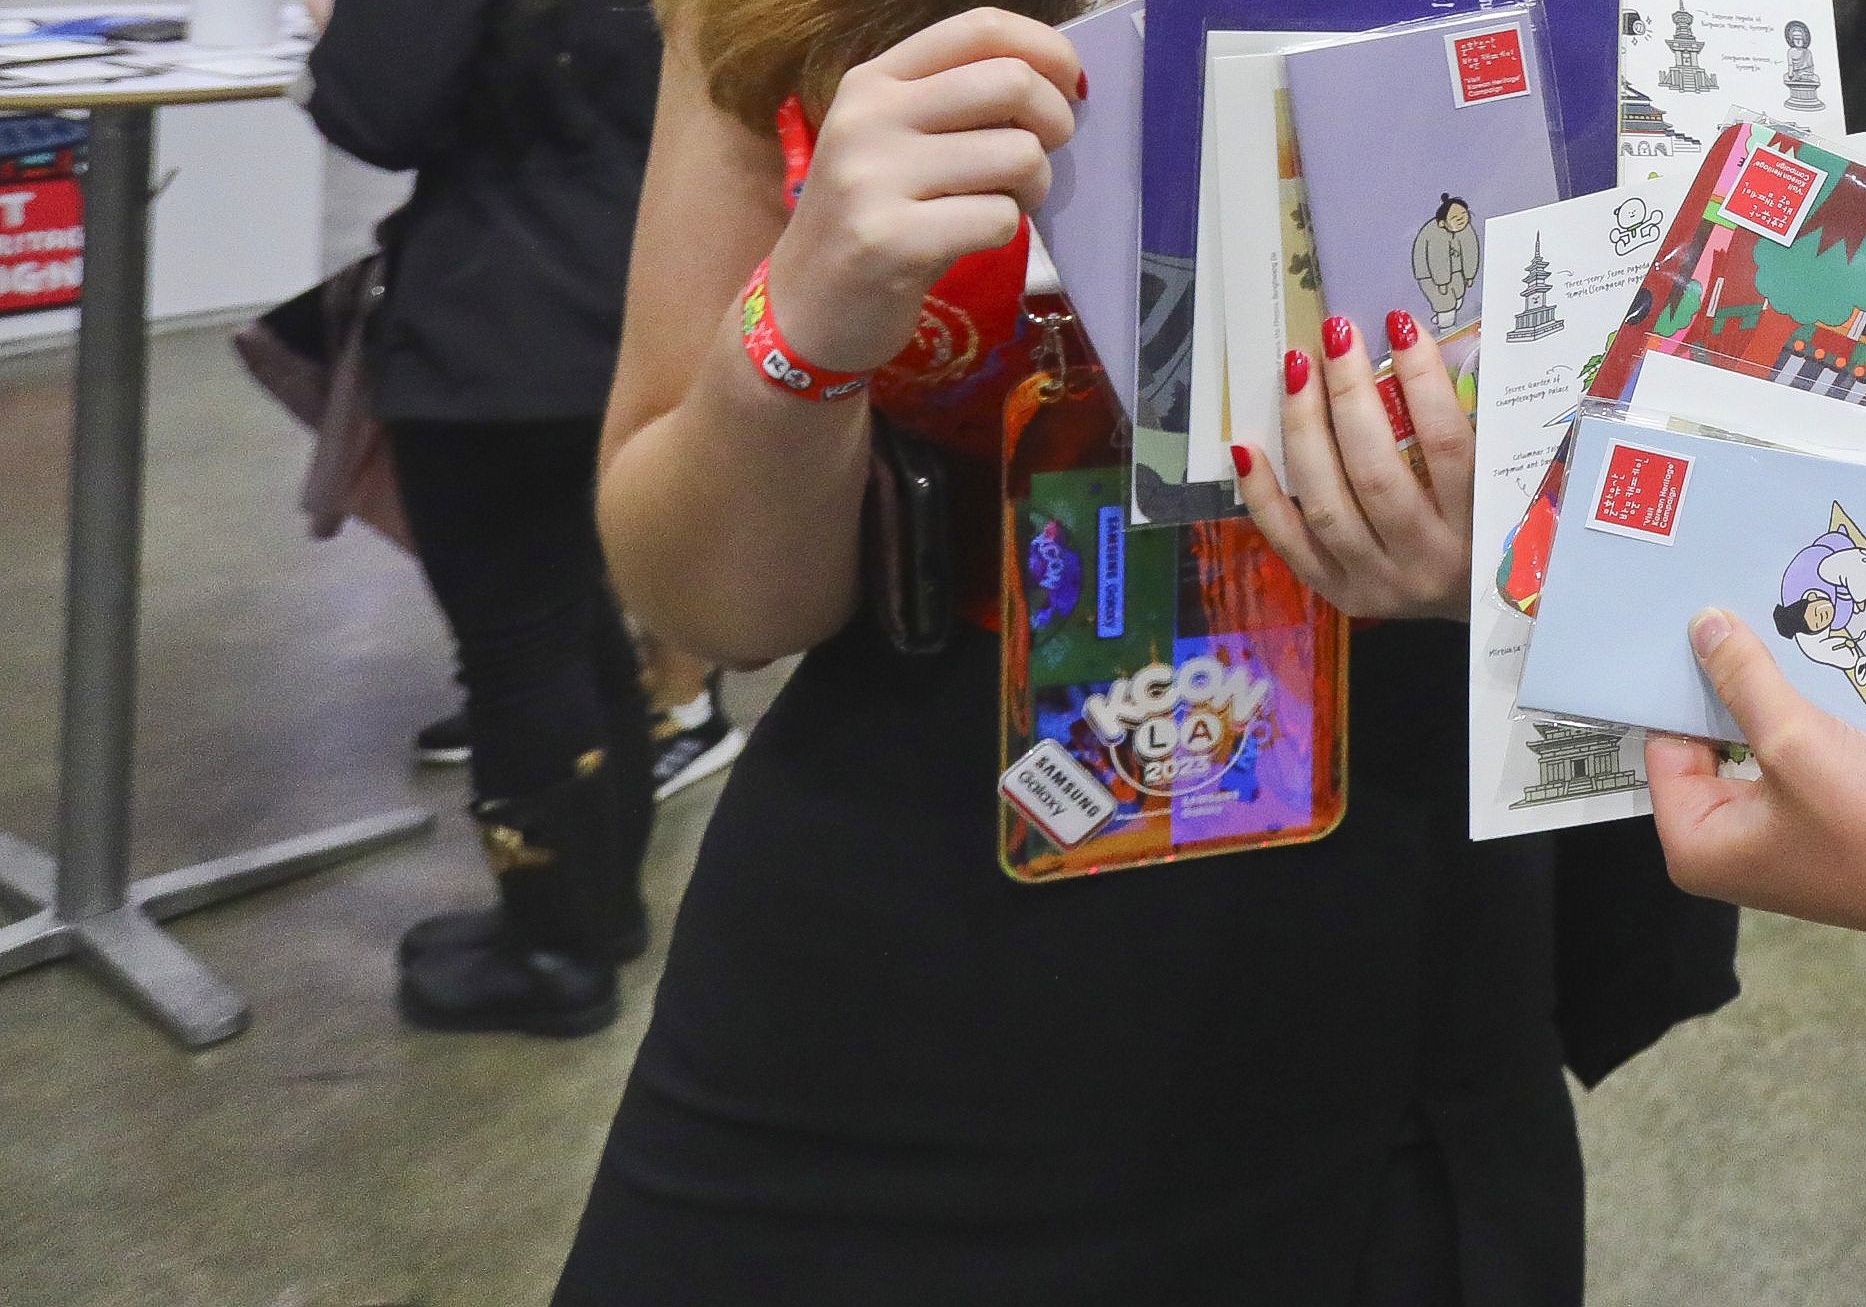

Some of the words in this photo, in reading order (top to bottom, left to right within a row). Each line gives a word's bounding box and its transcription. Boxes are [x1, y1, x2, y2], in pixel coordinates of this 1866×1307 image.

[1603, 473, 1626, 517] 문화유산
[1625, 458, 1650, 498] 캠페인
[1618, 500, 1641, 520] 방문
[1034, 755, 1101, 819] SAMSUNG
